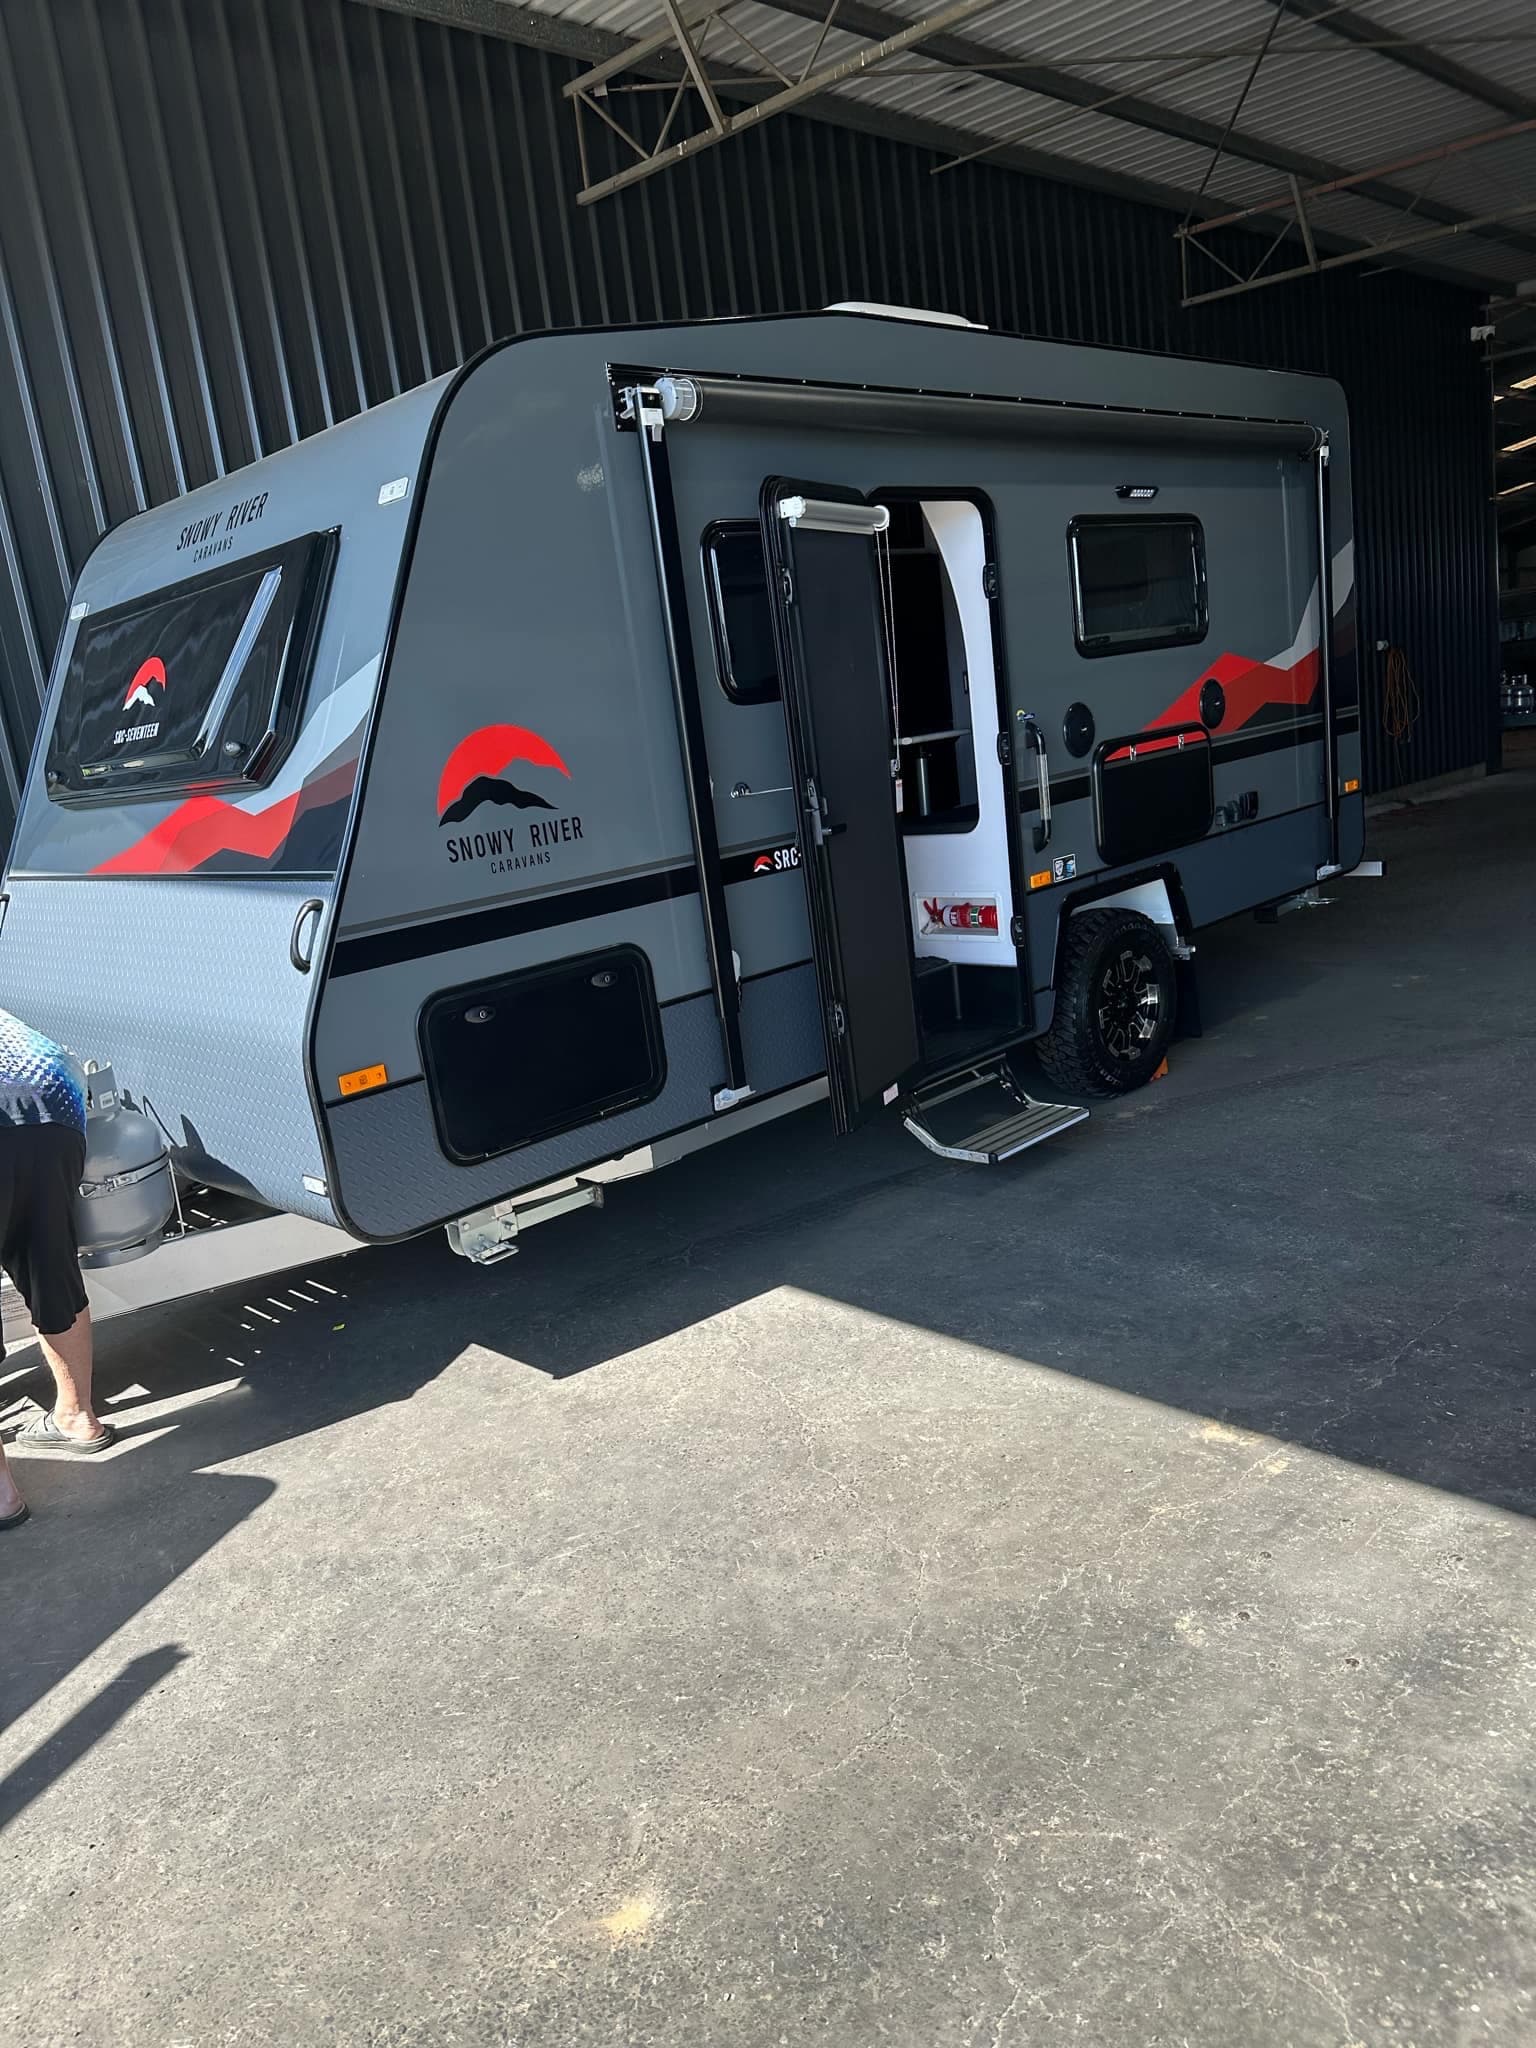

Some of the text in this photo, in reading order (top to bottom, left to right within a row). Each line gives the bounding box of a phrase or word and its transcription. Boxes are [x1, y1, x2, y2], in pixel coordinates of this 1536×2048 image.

[176, 491, 269, 551] SNOWY RIVER
[193, 535, 233, 563] CARAVANS
[446, 816, 584, 863] SNOWY RIVER
[490, 851, 551, 874] CARAVANS
